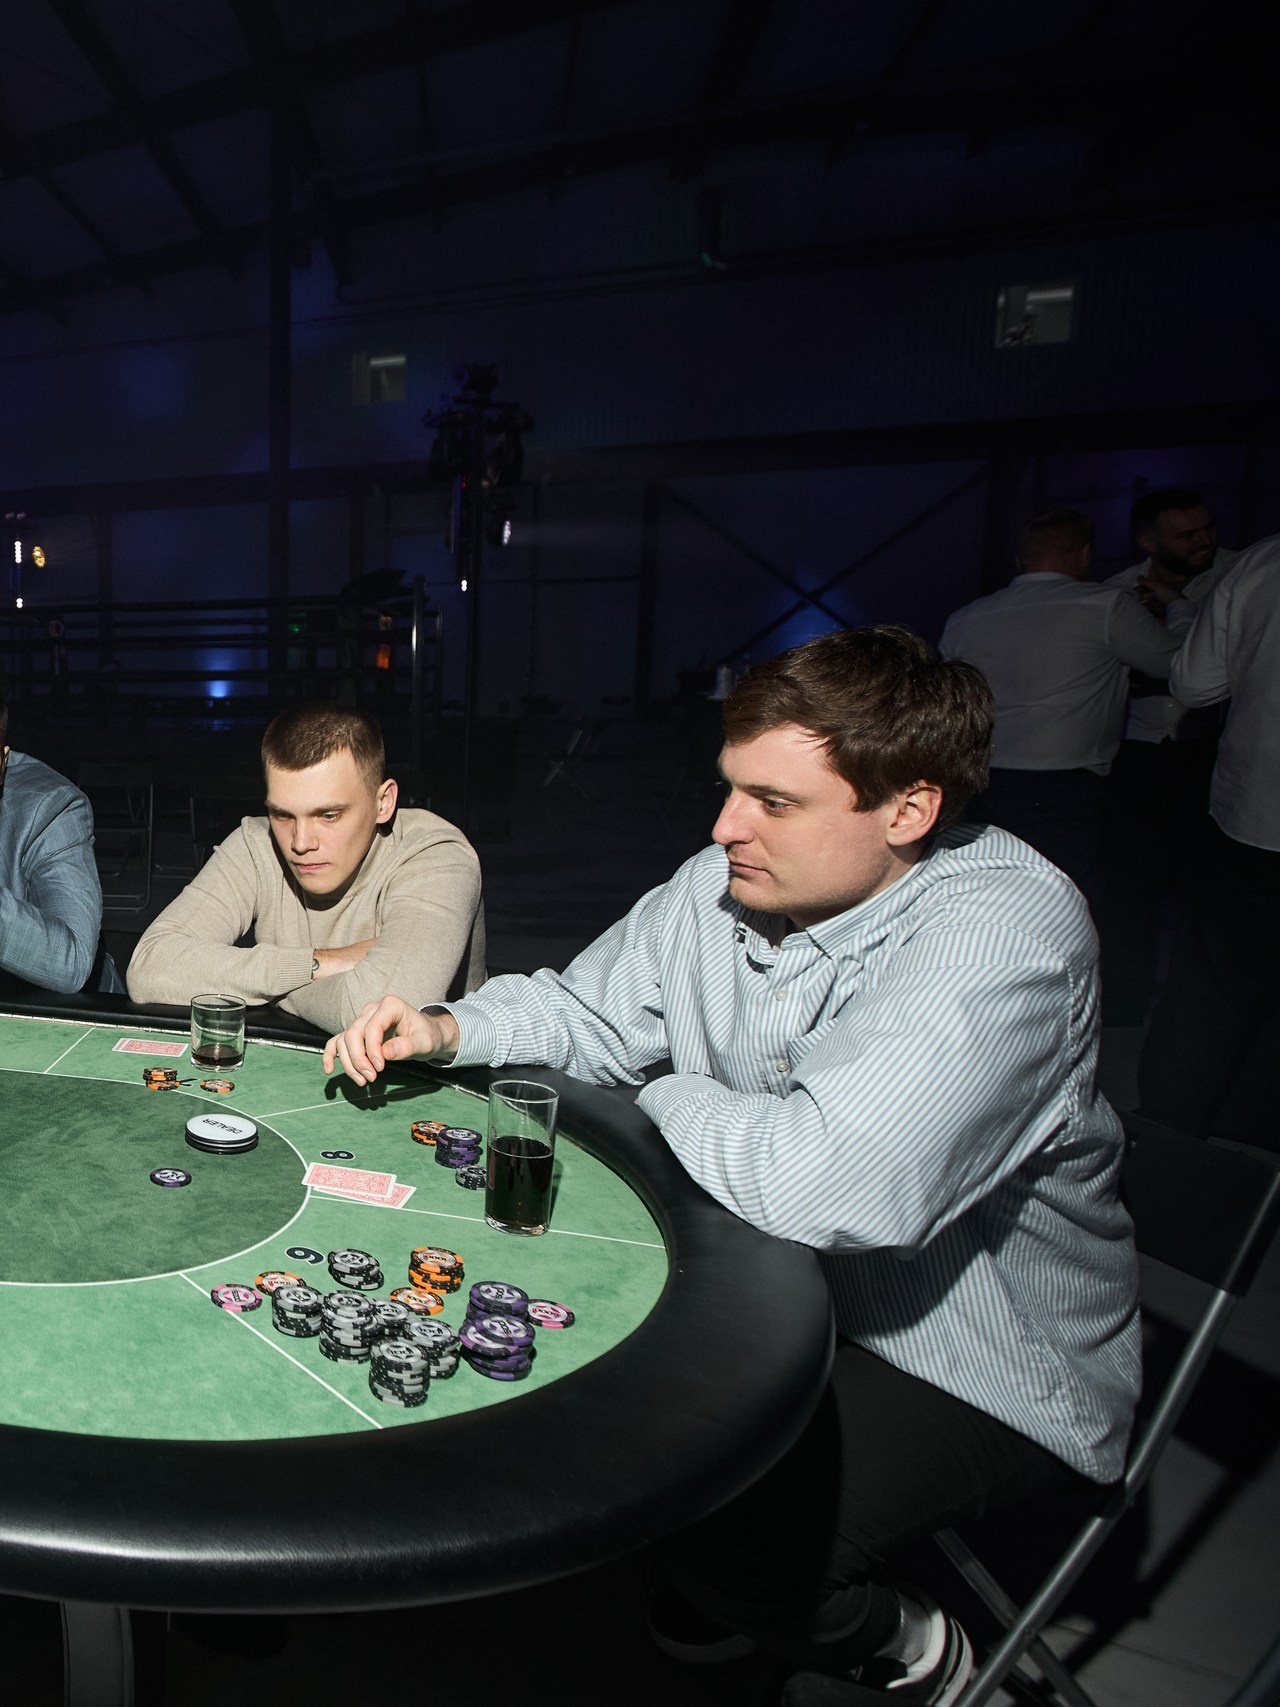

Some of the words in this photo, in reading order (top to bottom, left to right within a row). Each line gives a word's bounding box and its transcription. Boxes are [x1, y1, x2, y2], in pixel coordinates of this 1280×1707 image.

[202, 1118, 243, 1135] DEALER
[320, 1150, 355, 1160] 8
[284, 1246, 325, 1266] 9
[495, 1288, 506, 1300] 500
